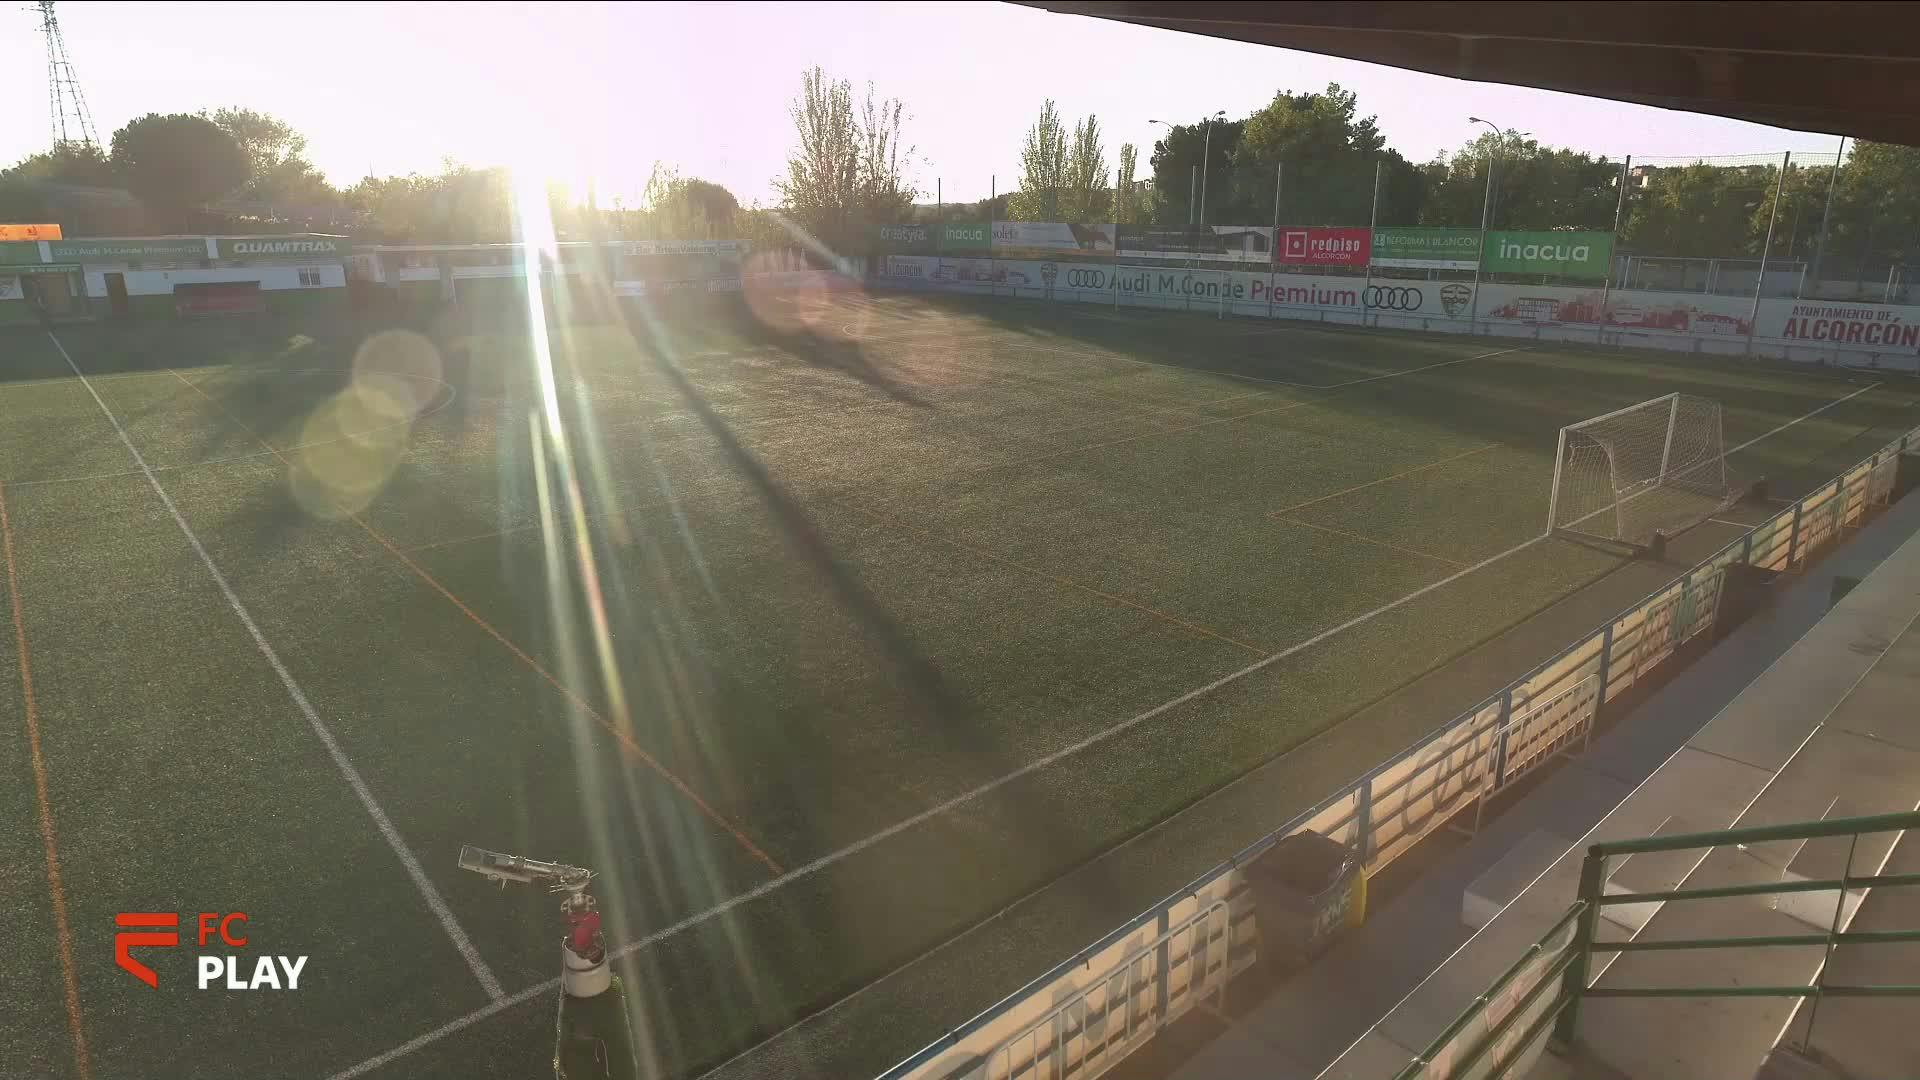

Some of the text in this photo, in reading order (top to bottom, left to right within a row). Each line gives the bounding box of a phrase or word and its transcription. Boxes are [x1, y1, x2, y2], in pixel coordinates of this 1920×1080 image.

[945, 225, 983, 241] inacua
[233, 240, 337, 254] QUAMTRAX
[1311, 237, 1361, 253] redpiso
[1499, 238, 1590, 263] inacua
[1109, 271, 1357, 305] Audi M.Conde Premium
[1792, 305, 1890, 321] AYUNTAMIENTO DE
[1783, 317, 1920, 347] ALCORCÓN
